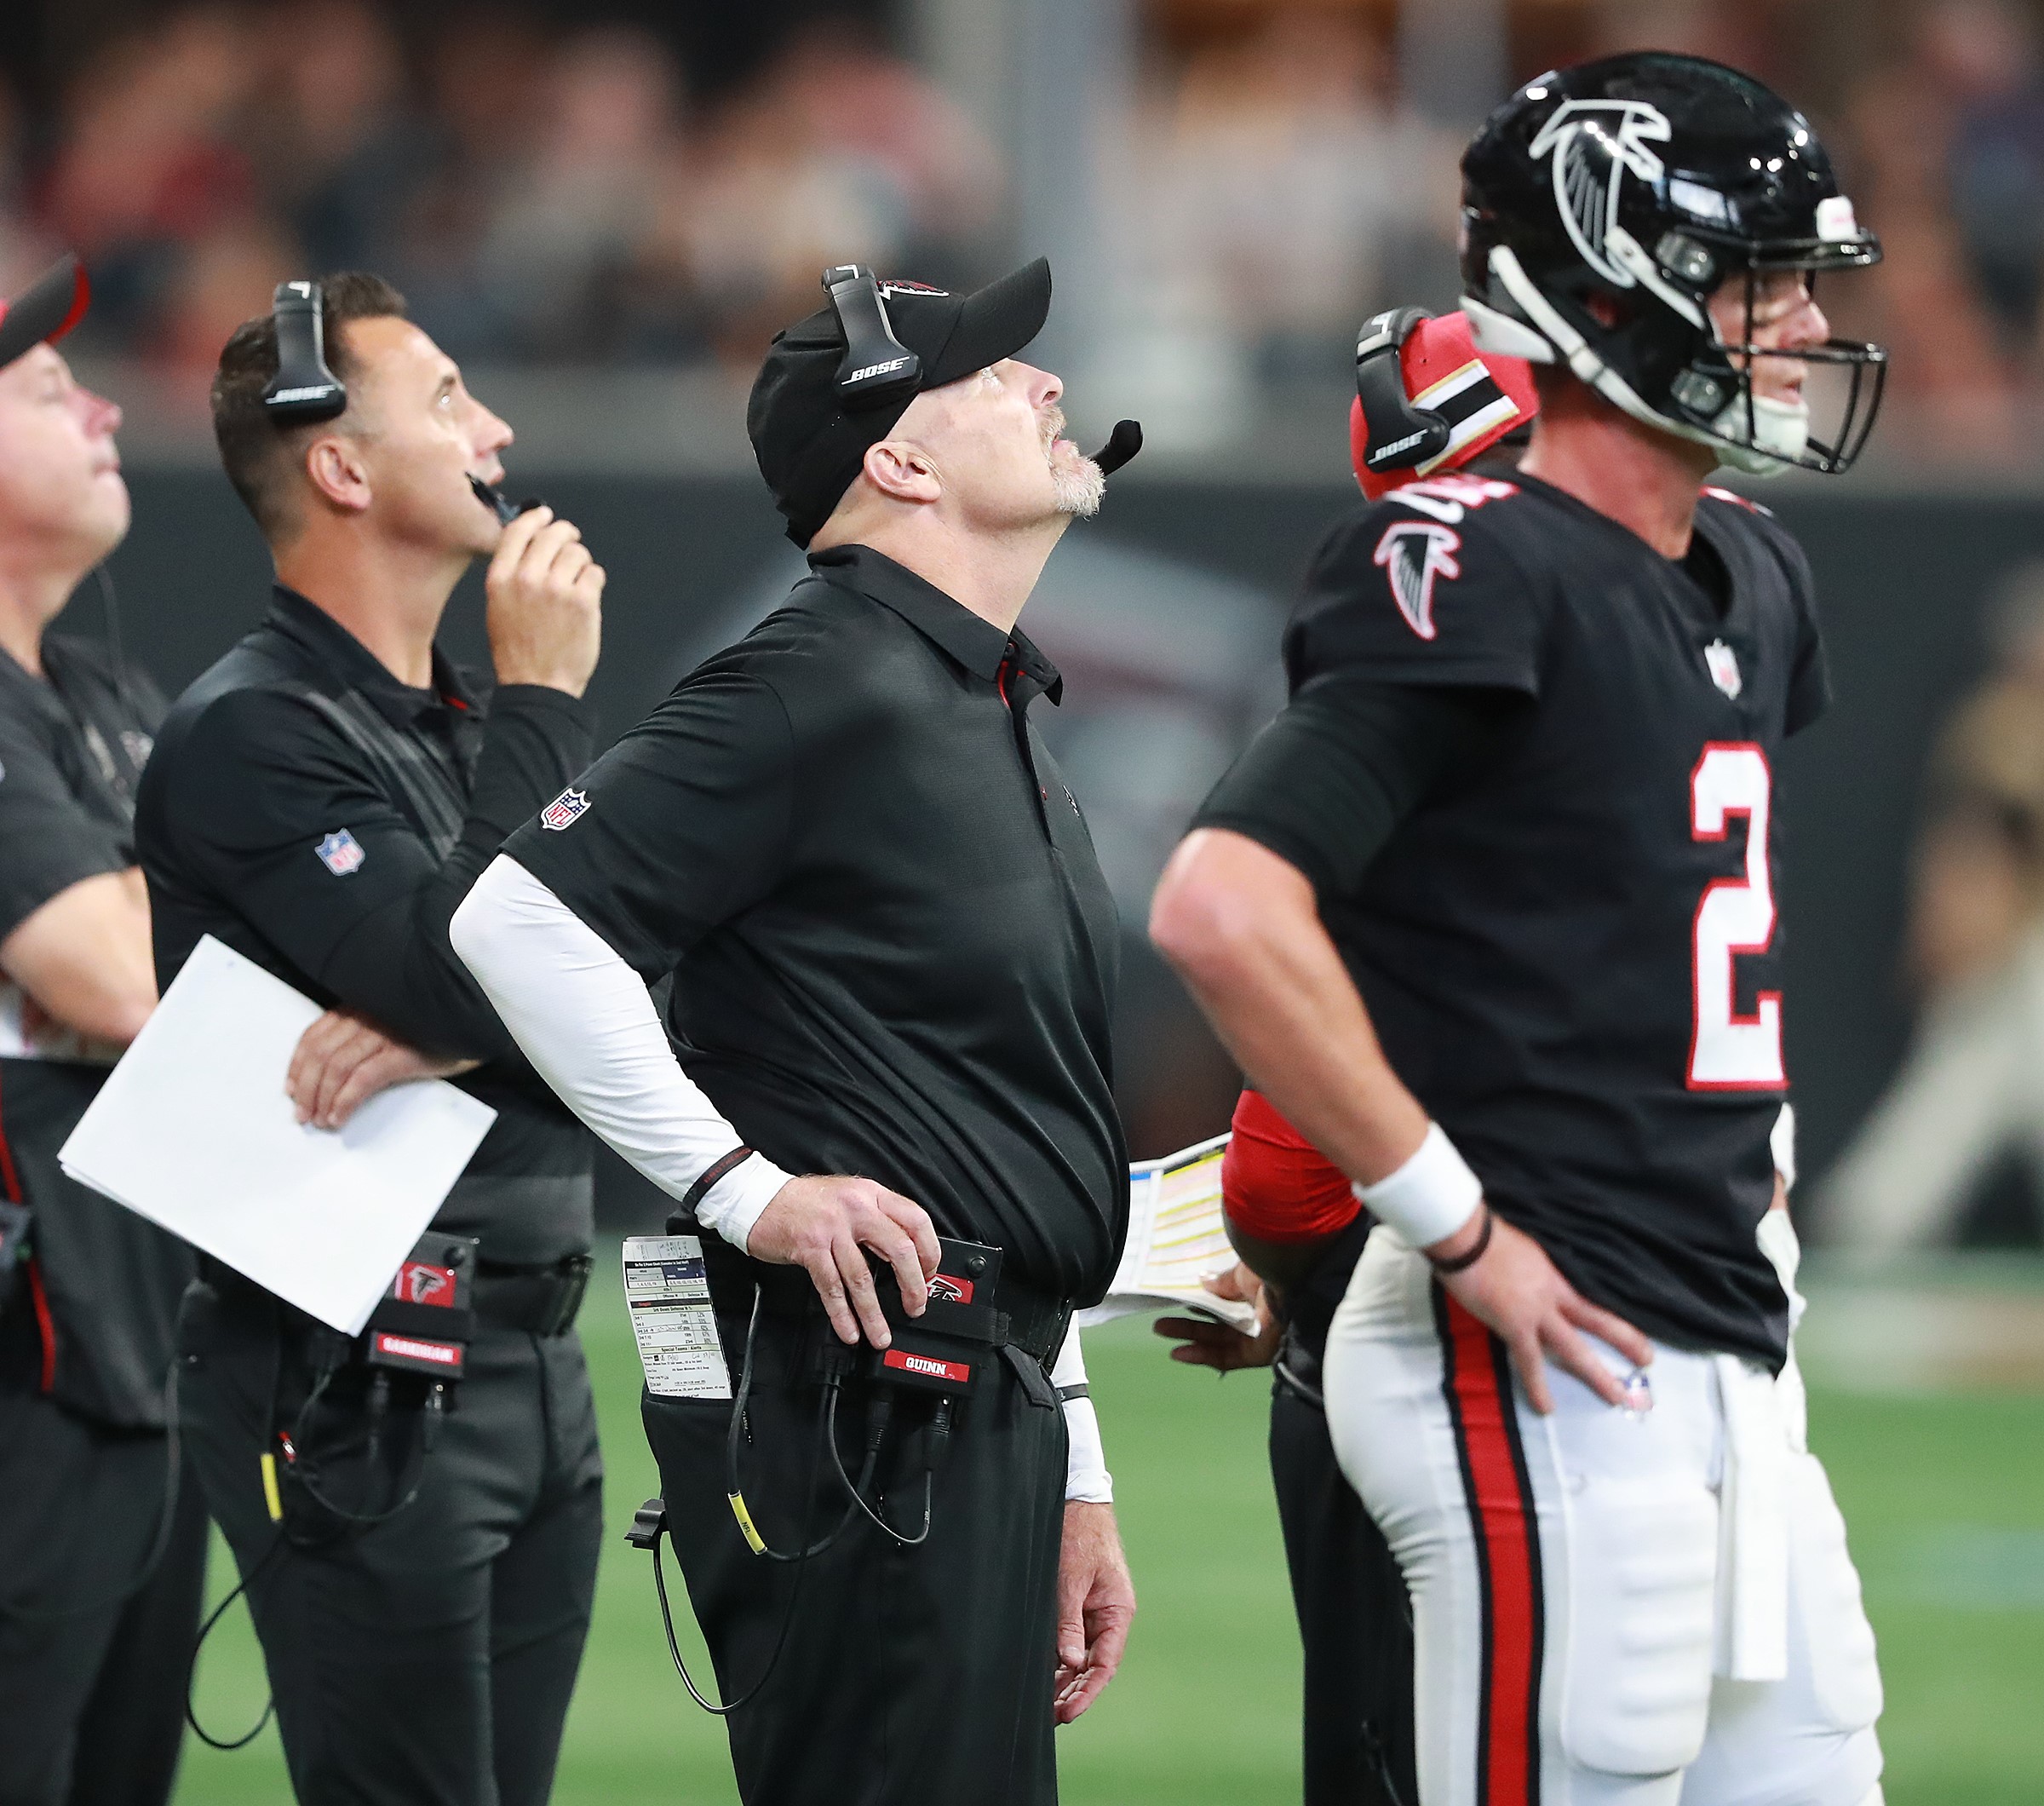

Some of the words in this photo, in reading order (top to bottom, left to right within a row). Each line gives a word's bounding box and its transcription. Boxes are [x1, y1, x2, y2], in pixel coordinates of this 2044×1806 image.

[841, 356, 910, 386] BOSE
[1368, 428, 1428, 465] BOSE
[548, 804, 571, 825] NFL
[1685, 740, 1790, 1091] 2
[905, 1356, 947, 1375] QUINN
[741, 1521, 751, 1533] NFL
